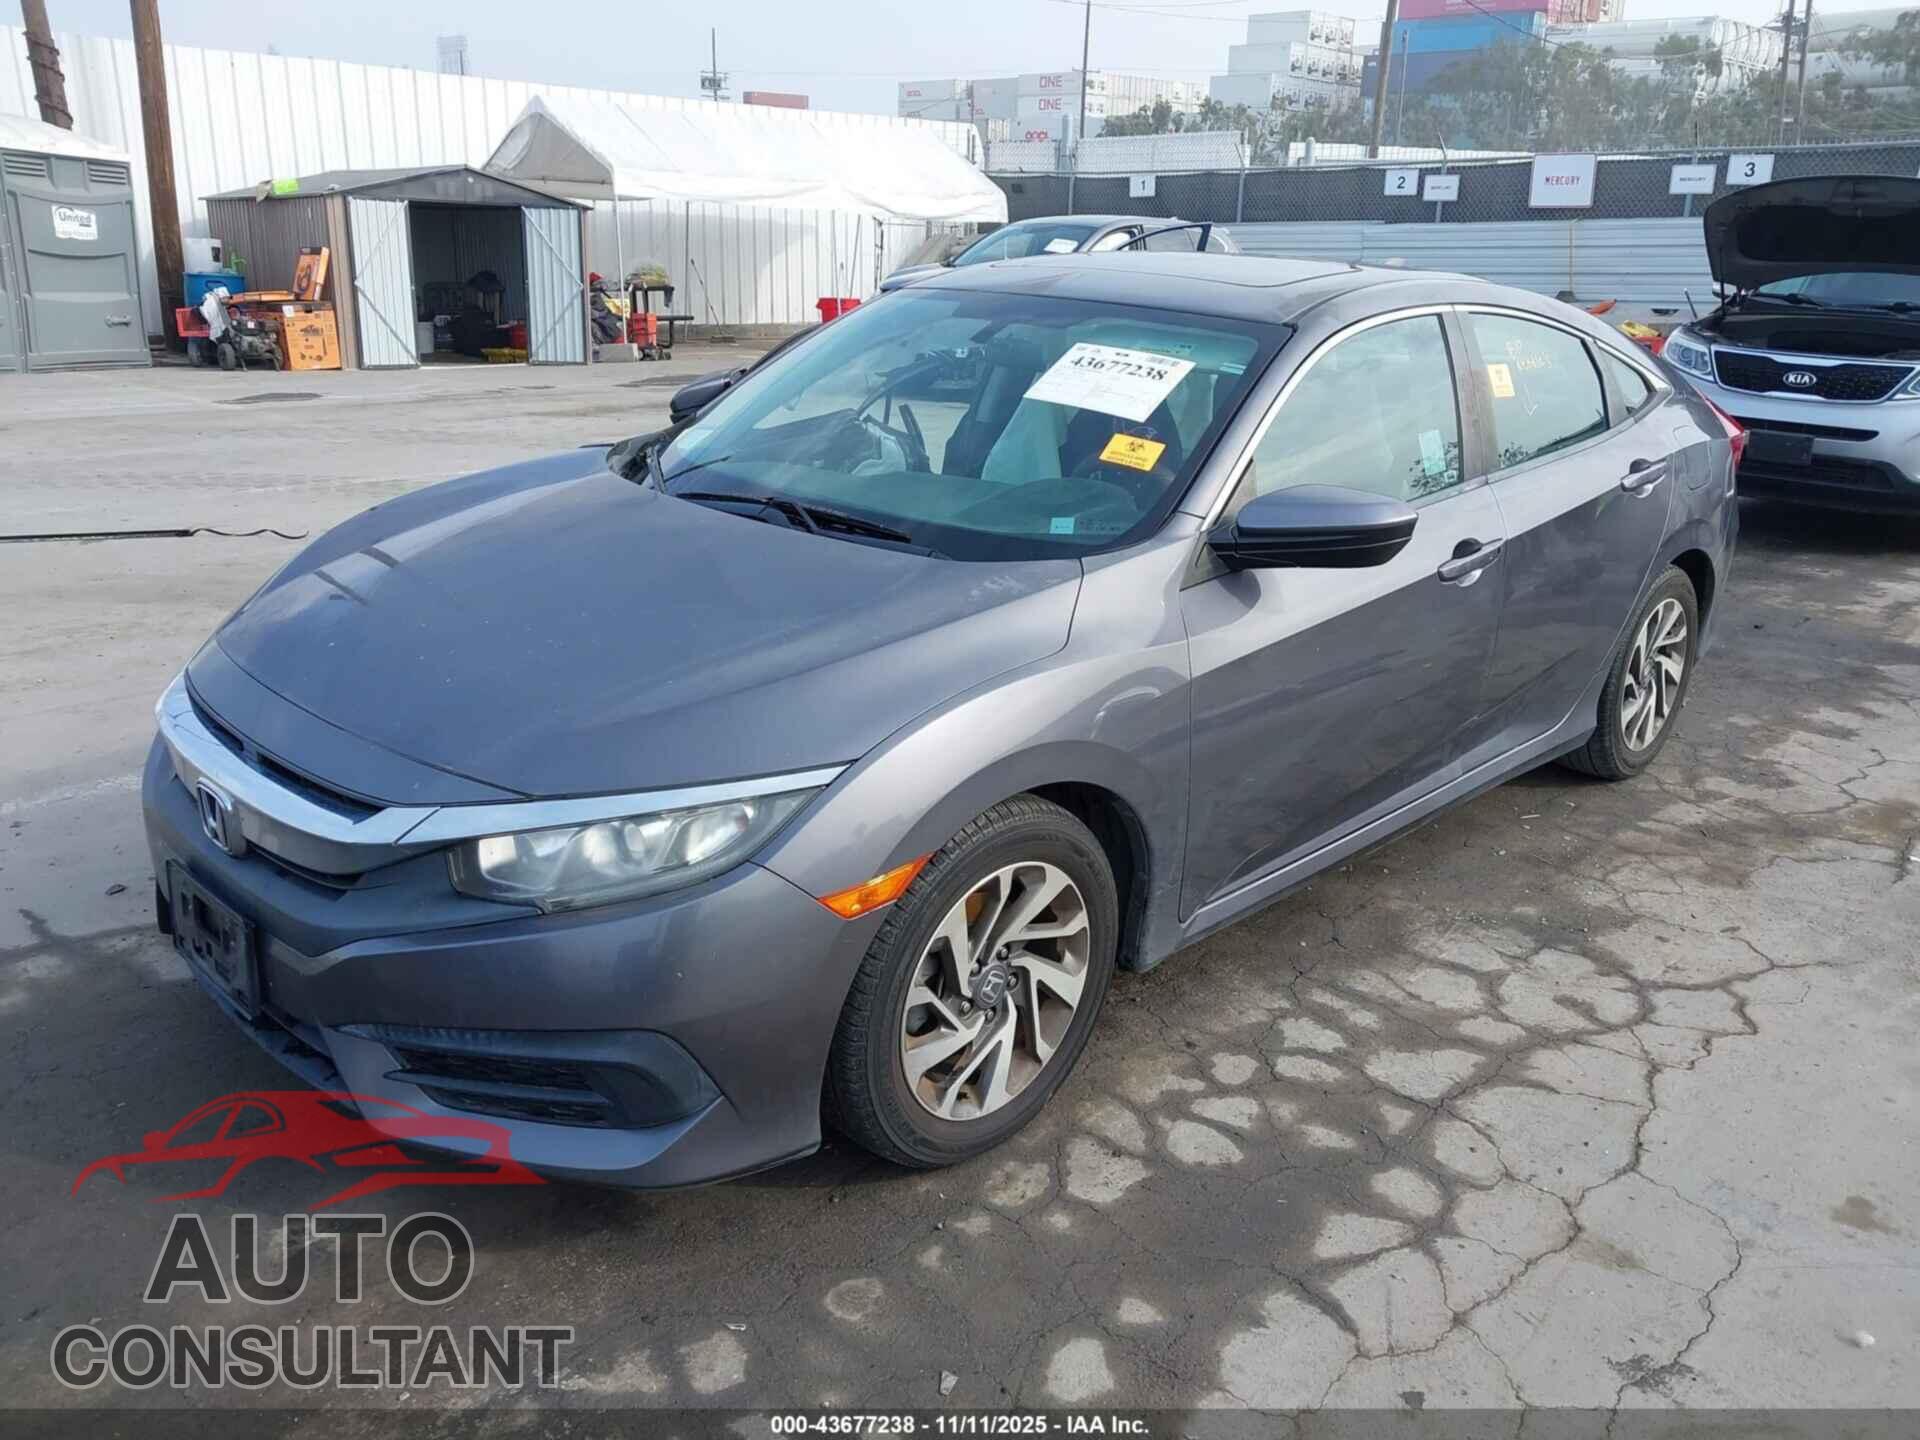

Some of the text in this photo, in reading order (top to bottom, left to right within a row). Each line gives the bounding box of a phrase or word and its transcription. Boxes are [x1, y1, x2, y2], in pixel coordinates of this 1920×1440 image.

[1040, 75, 1063, 88] ONE
[1039, 98, 1062, 111] ONE
[1743, 161, 1756, 178] 3
[1396, 175, 1406, 190] 2
[1544, 175, 1581, 186] MERCURY
[58, 210, 92, 225] United
[1070, 355, 1169, 382] 43677238
[1788, 373, 1810, 384] KIA
